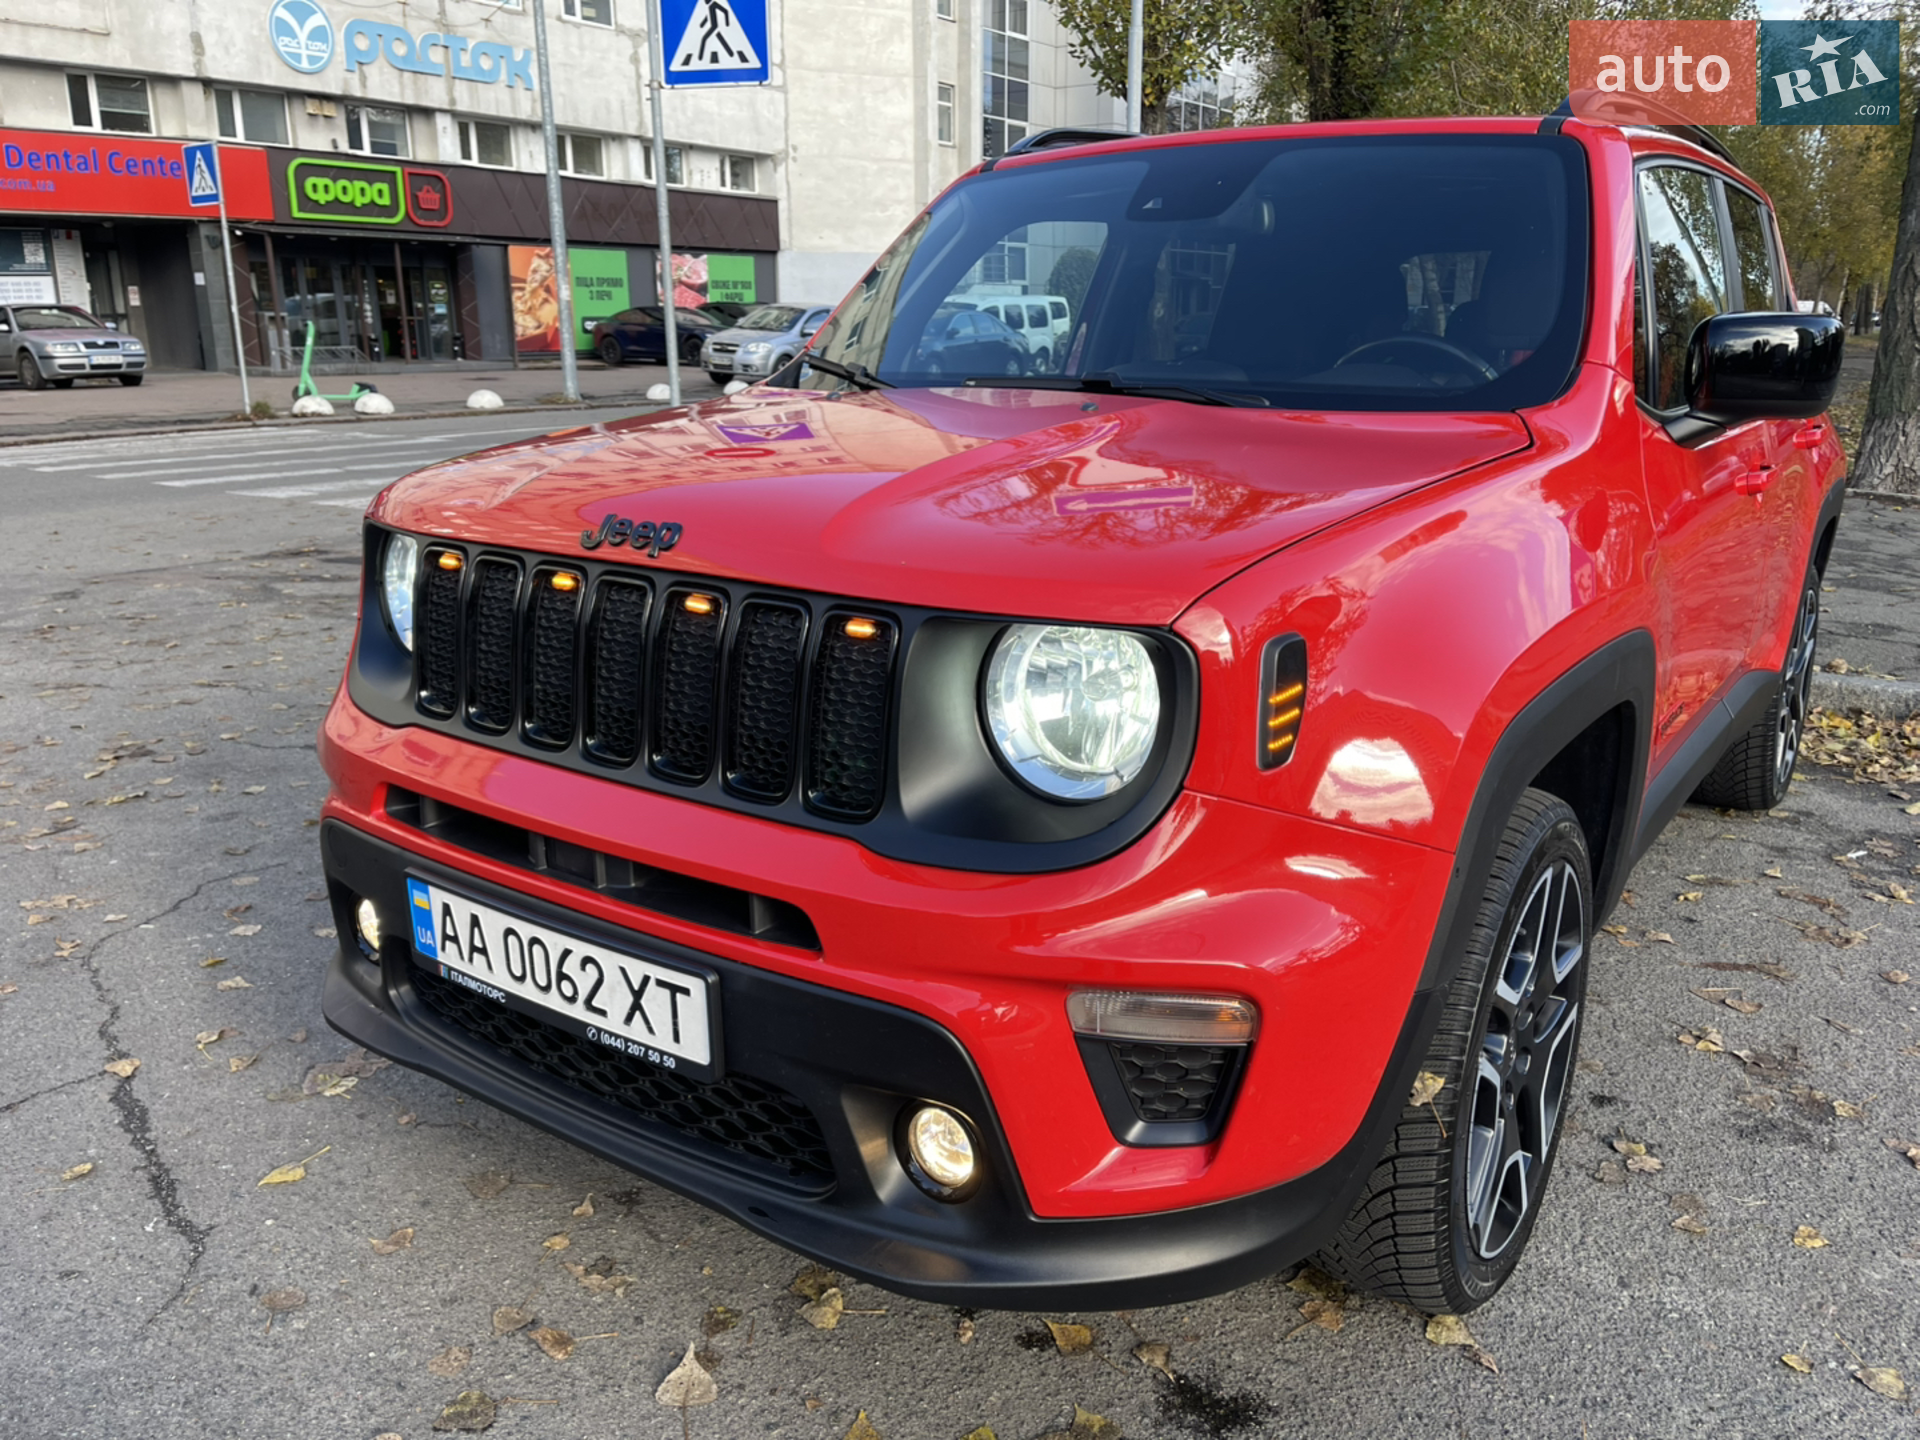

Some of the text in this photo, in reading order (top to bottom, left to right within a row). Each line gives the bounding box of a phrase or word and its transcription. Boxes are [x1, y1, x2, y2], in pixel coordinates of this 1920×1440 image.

[4, 143, 183, 179] Dental Cente
[595, 276, 624, 288] ПРЯМО
[581, 513, 683, 558] Jeep
[417, 926, 435, 947] UA
[440, 900, 692, 1045] AA 0062 XT
[600, 1031, 676, 1069] (044) 207 50 50
